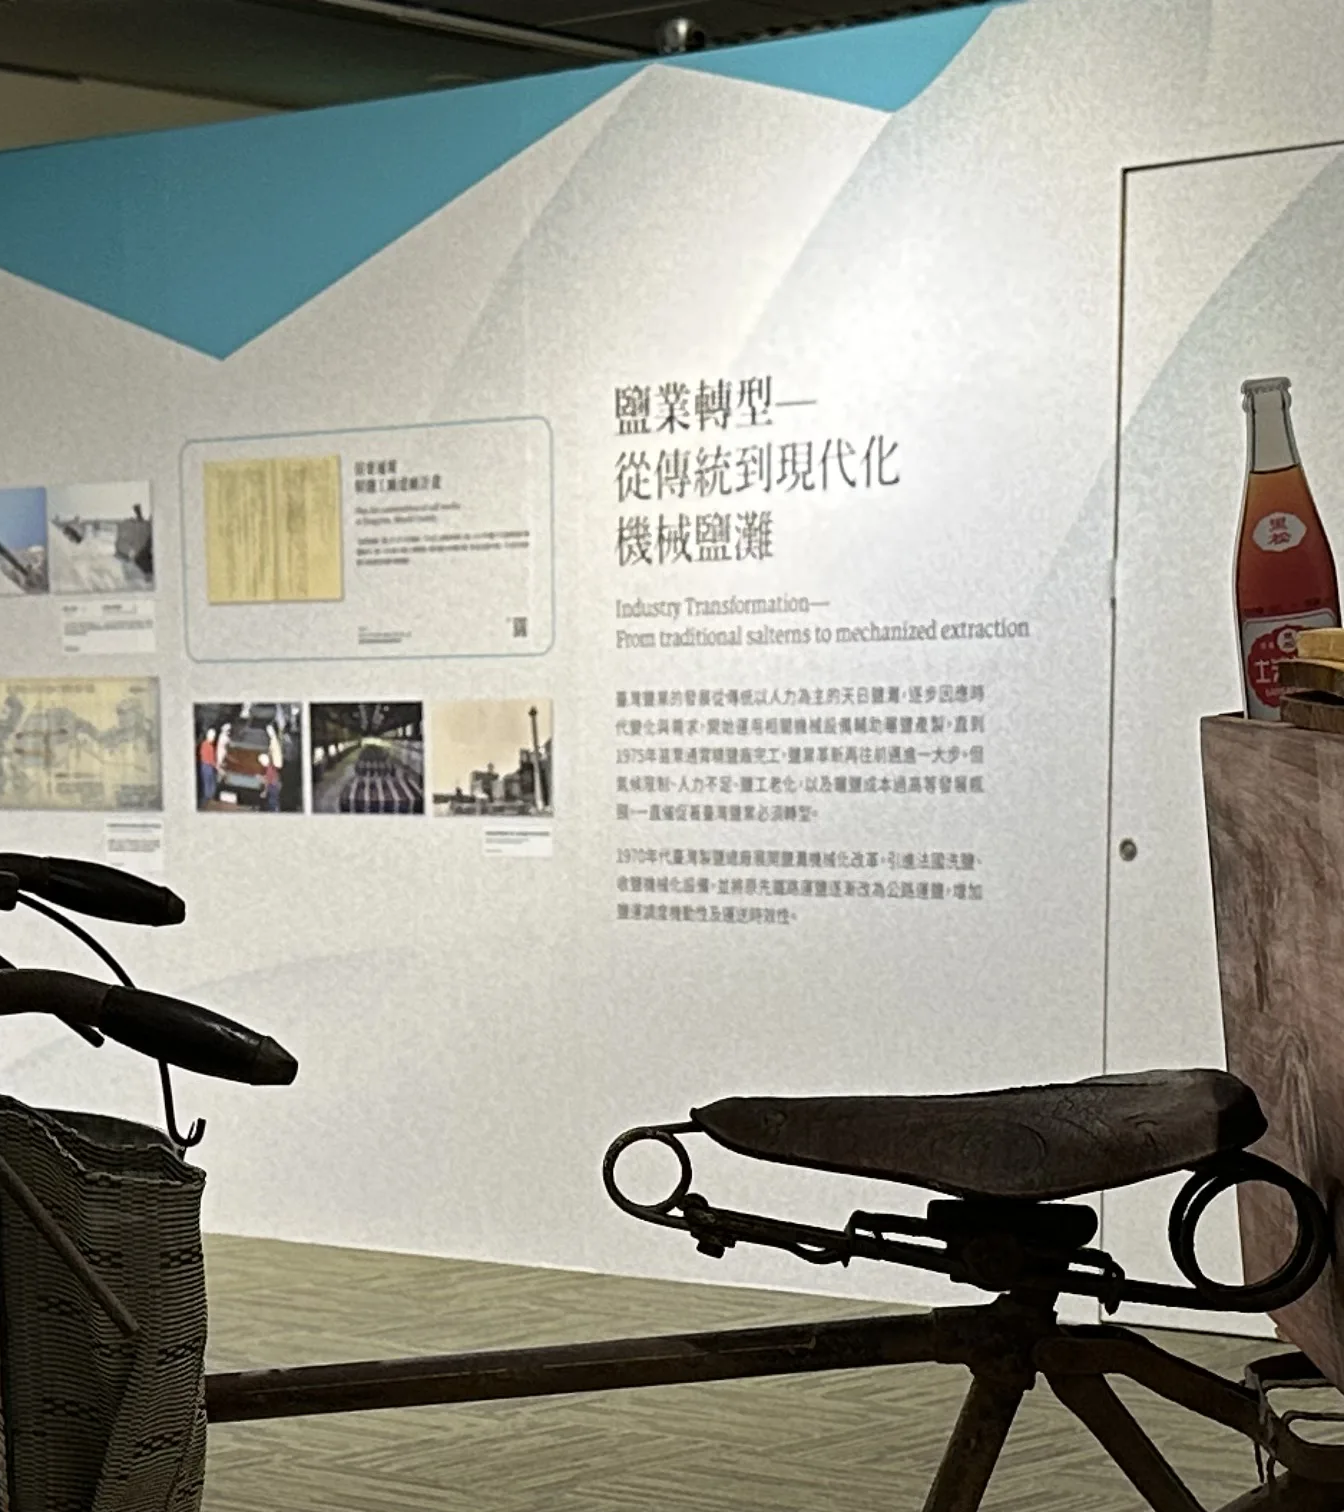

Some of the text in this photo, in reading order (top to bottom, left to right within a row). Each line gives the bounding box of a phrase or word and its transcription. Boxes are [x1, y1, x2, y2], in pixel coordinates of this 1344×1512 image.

[614, 434, 901, 502] 從傳統到現代化
[615, 511, 774, 567] 機械鹽灘
[616, 598, 681, 620] Industry
[616, 617, 1031, 649] From traditional salterns to mechanized extraction
